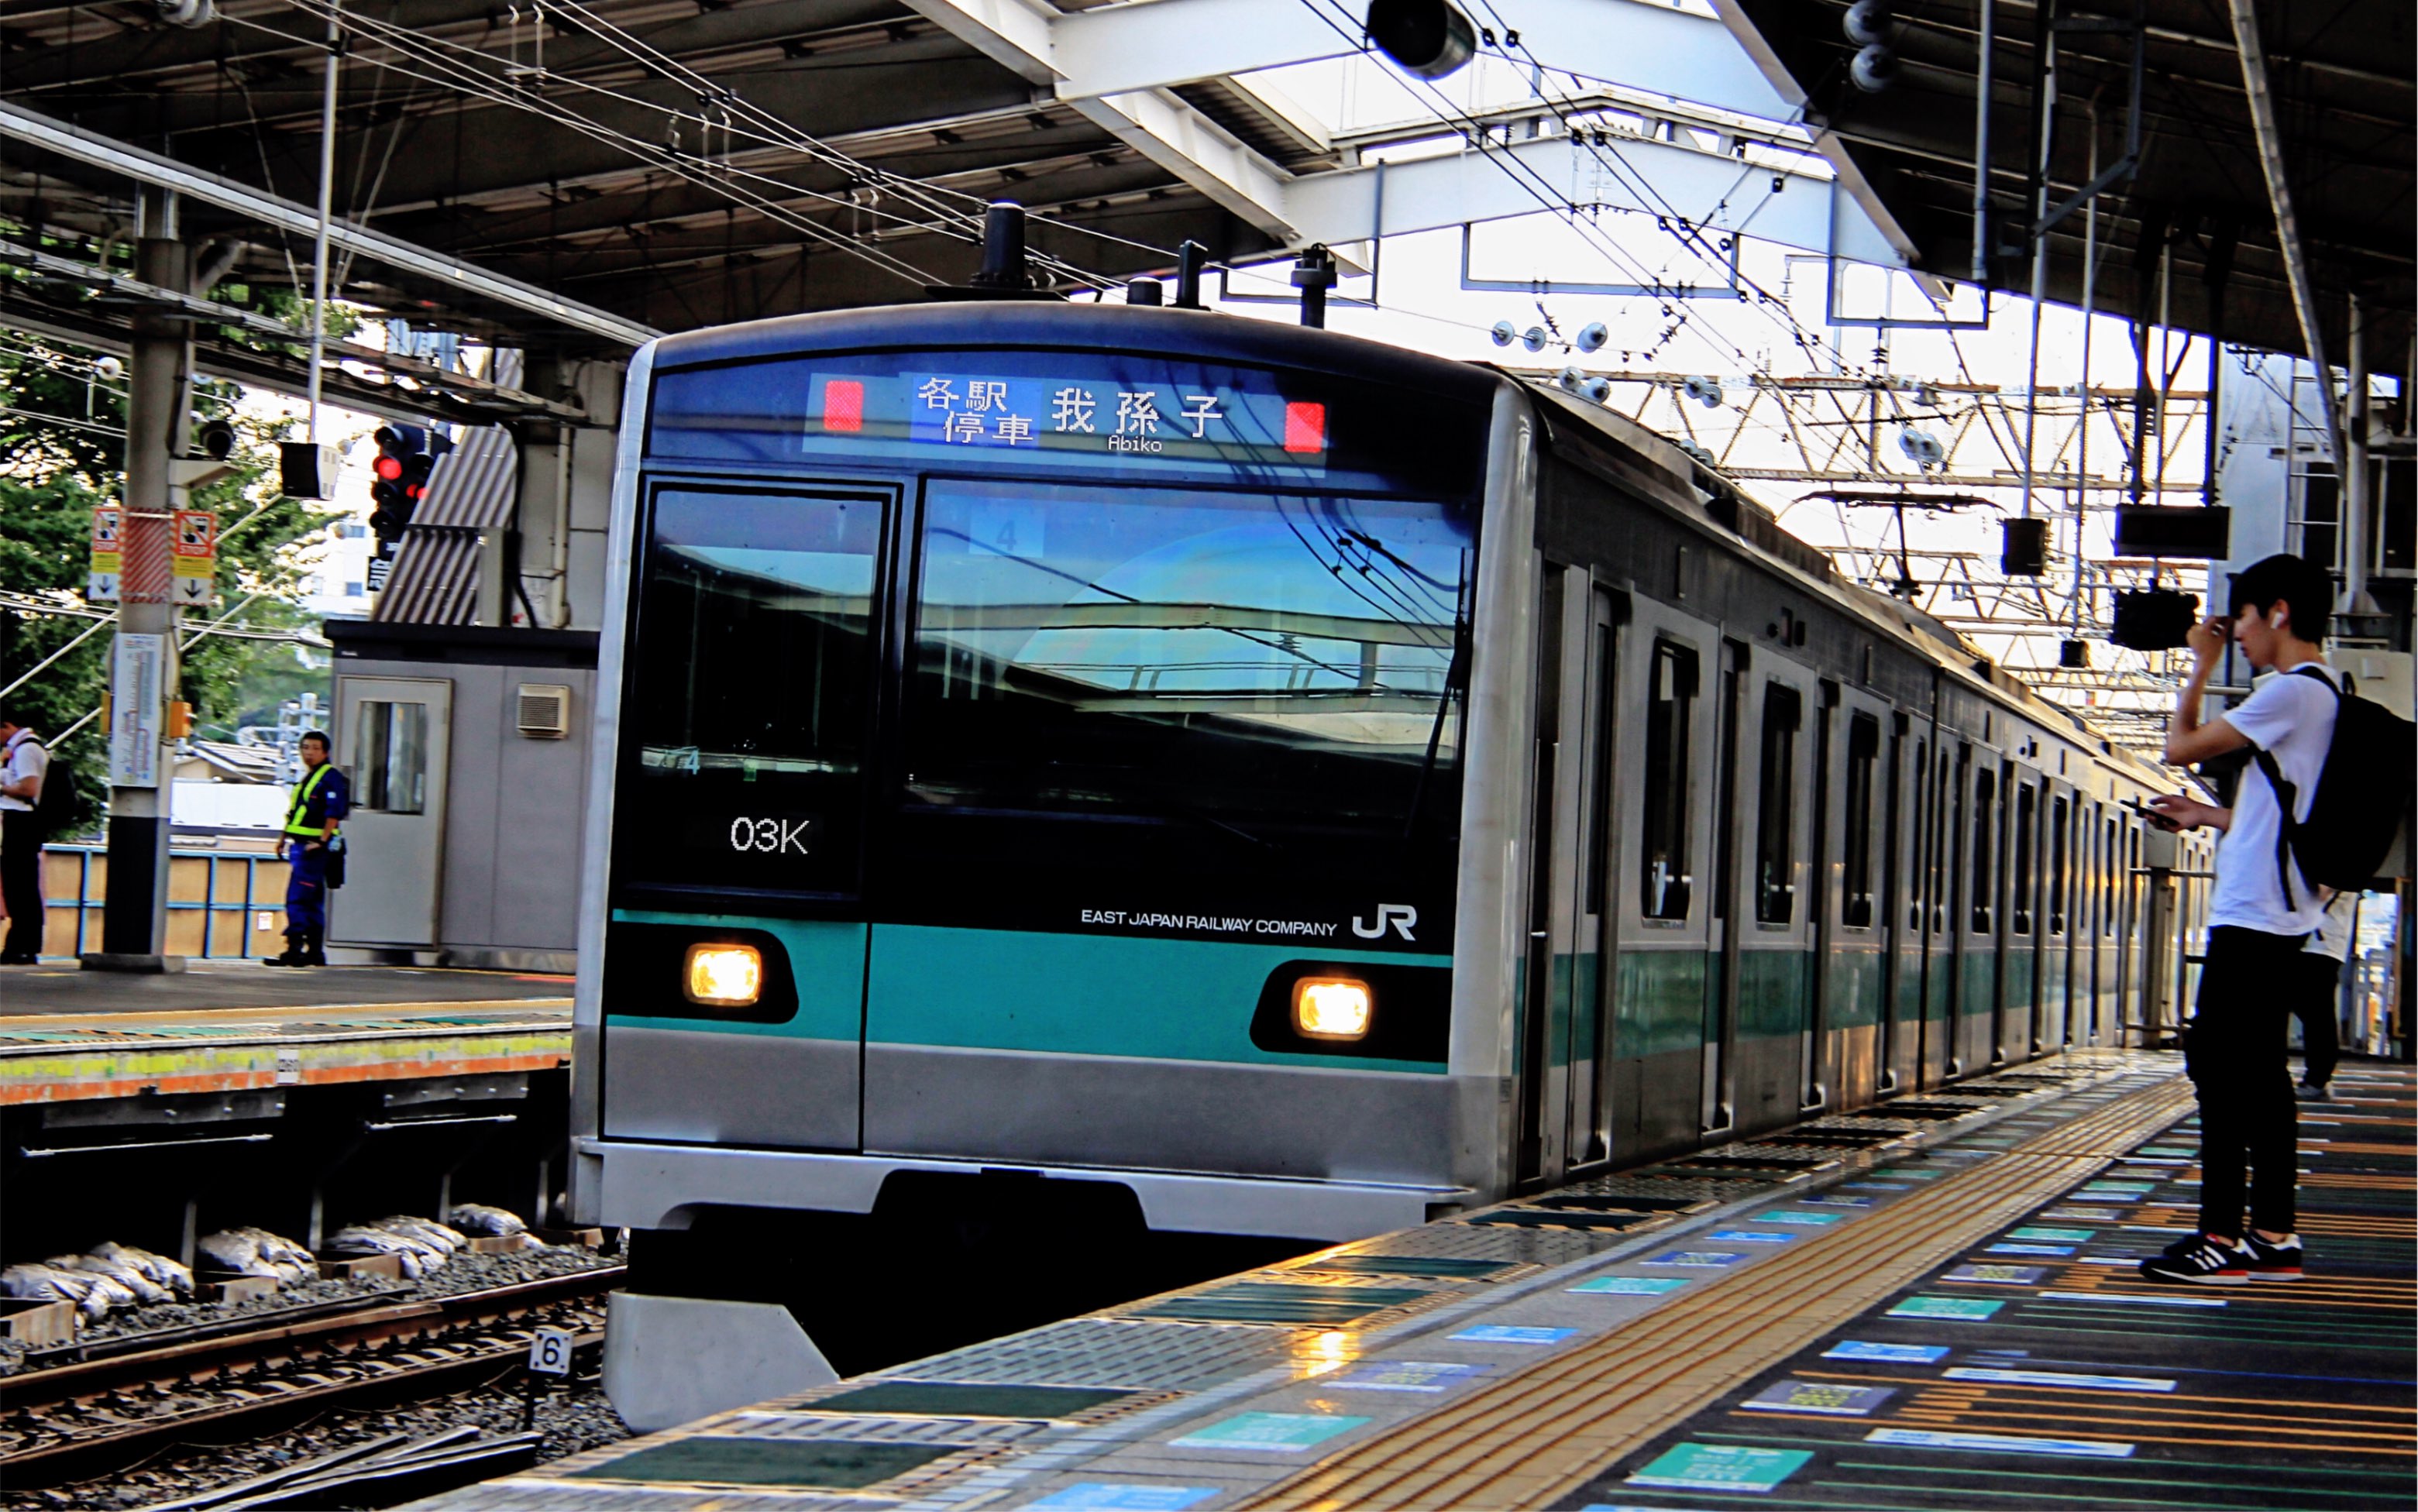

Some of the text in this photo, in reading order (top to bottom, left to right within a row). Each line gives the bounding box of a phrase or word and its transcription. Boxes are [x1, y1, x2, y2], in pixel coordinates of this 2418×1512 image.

[918, 377, 1007, 412] 各駅
[943, 411, 1034, 445] 停車
[1051, 387, 1223, 438] 我孫子
[1108, 435, 1162, 452] Abiko
[178, 545, 209, 555] STOP
[731, 817, 810, 854] 03K
[1081, 909, 1338, 936] EAST JAPAN RAILWAY COMPANY
[1352, 903, 1418, 941] JR
[543, 1337, 560, 1366] 6
